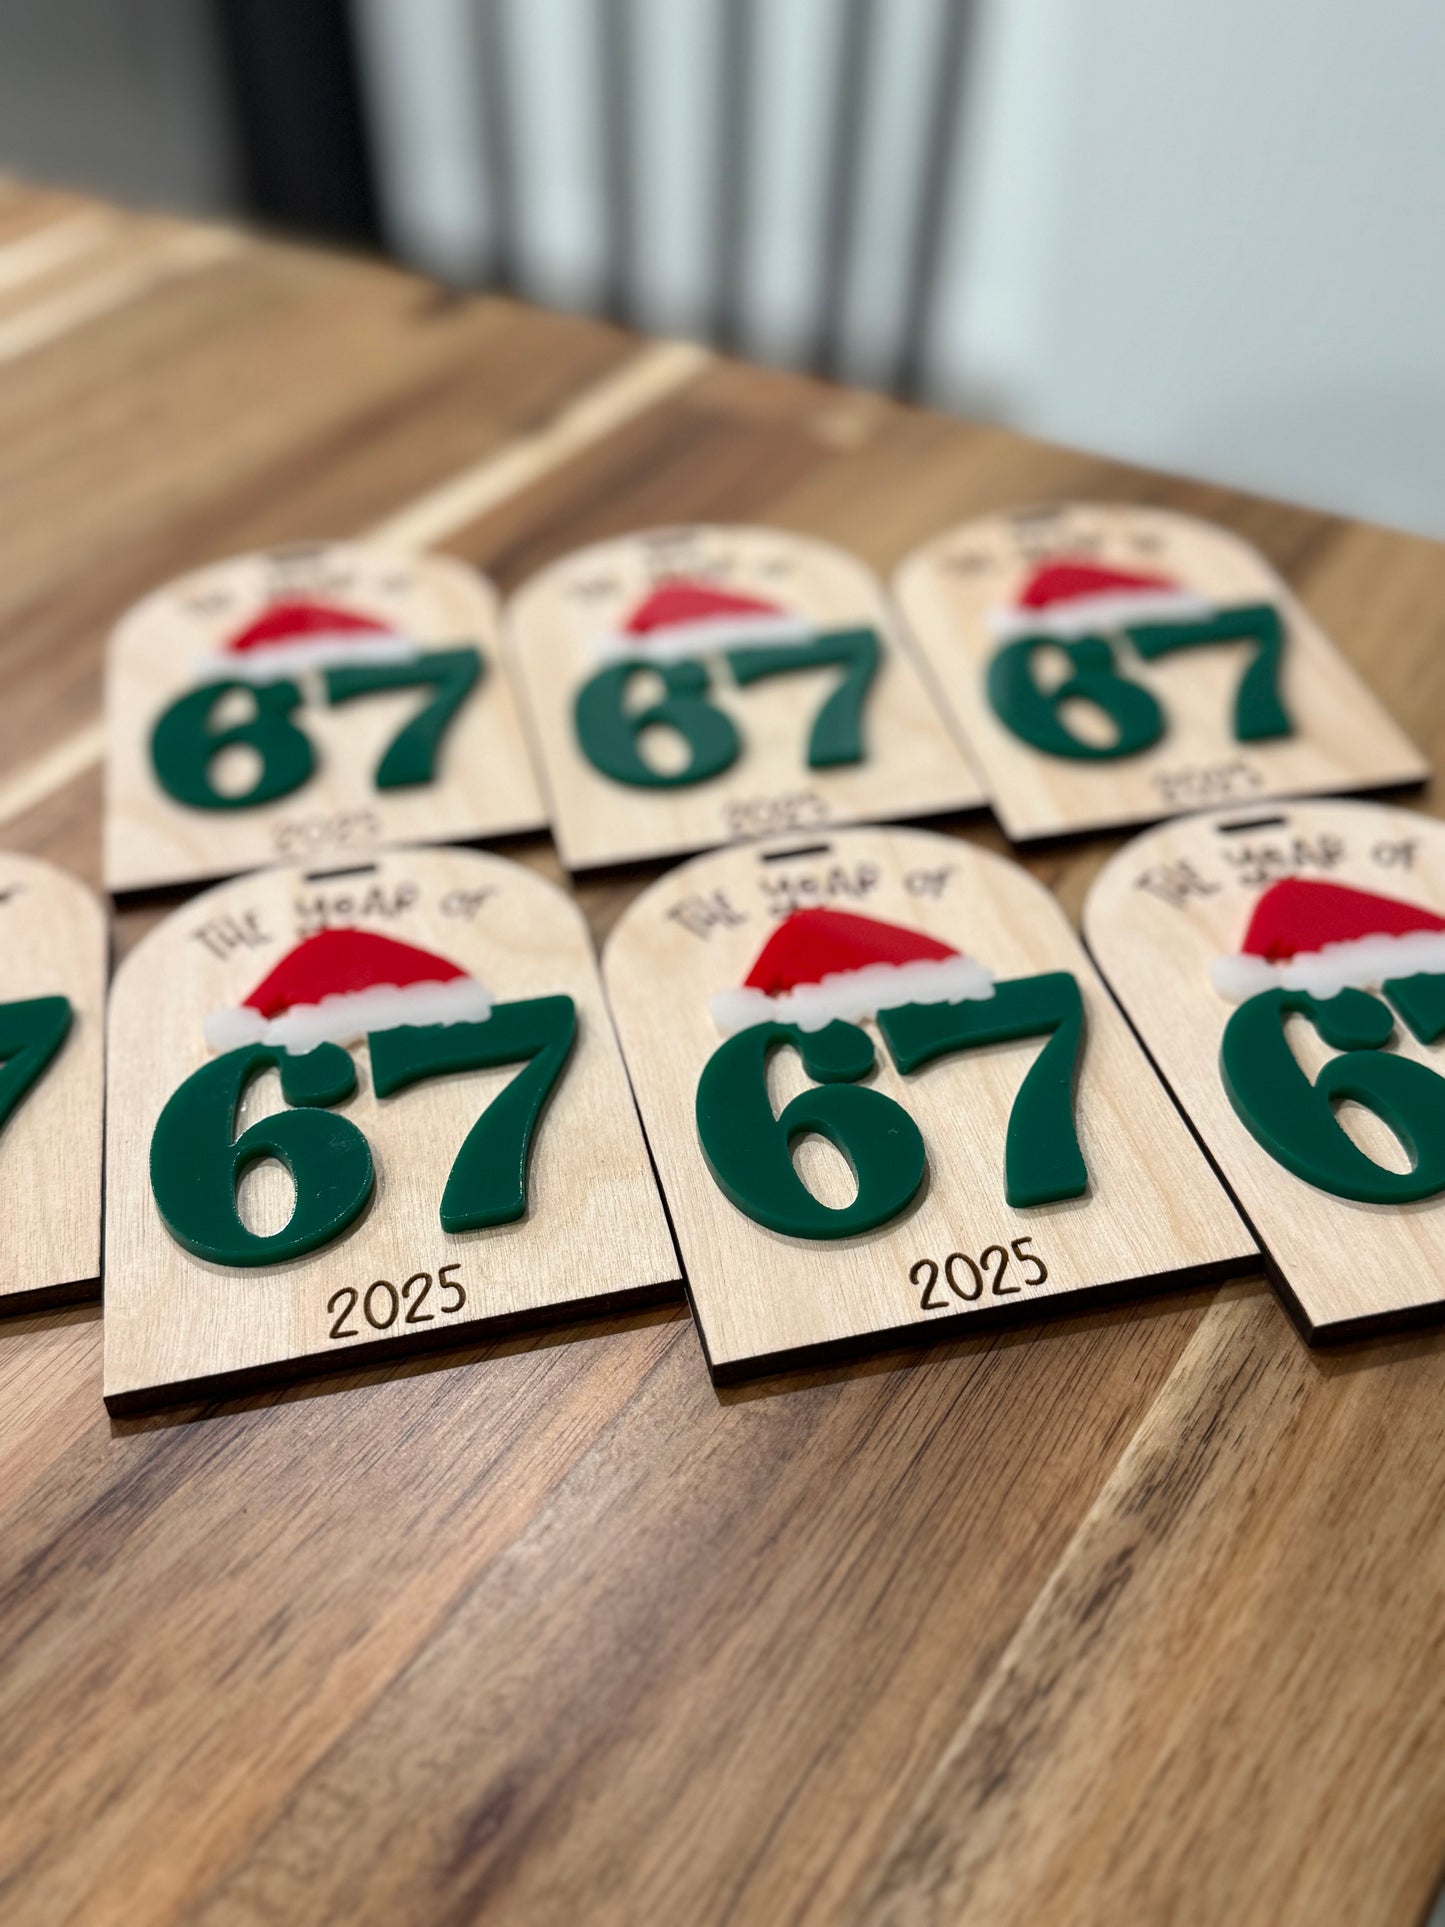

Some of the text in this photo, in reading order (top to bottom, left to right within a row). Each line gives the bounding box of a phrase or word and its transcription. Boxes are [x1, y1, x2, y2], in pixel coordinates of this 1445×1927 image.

[149, 645, 488, 814] 67
[573, 624, 884, 790] 67
[986, 604, 1295, 764] 67
[150, 994, 576, 1267] 67
[696, 971, 1088, 1240] 67
[327, 1263, 467, 1339] 2025
[908, 1236, 1049, 1311] 2025
